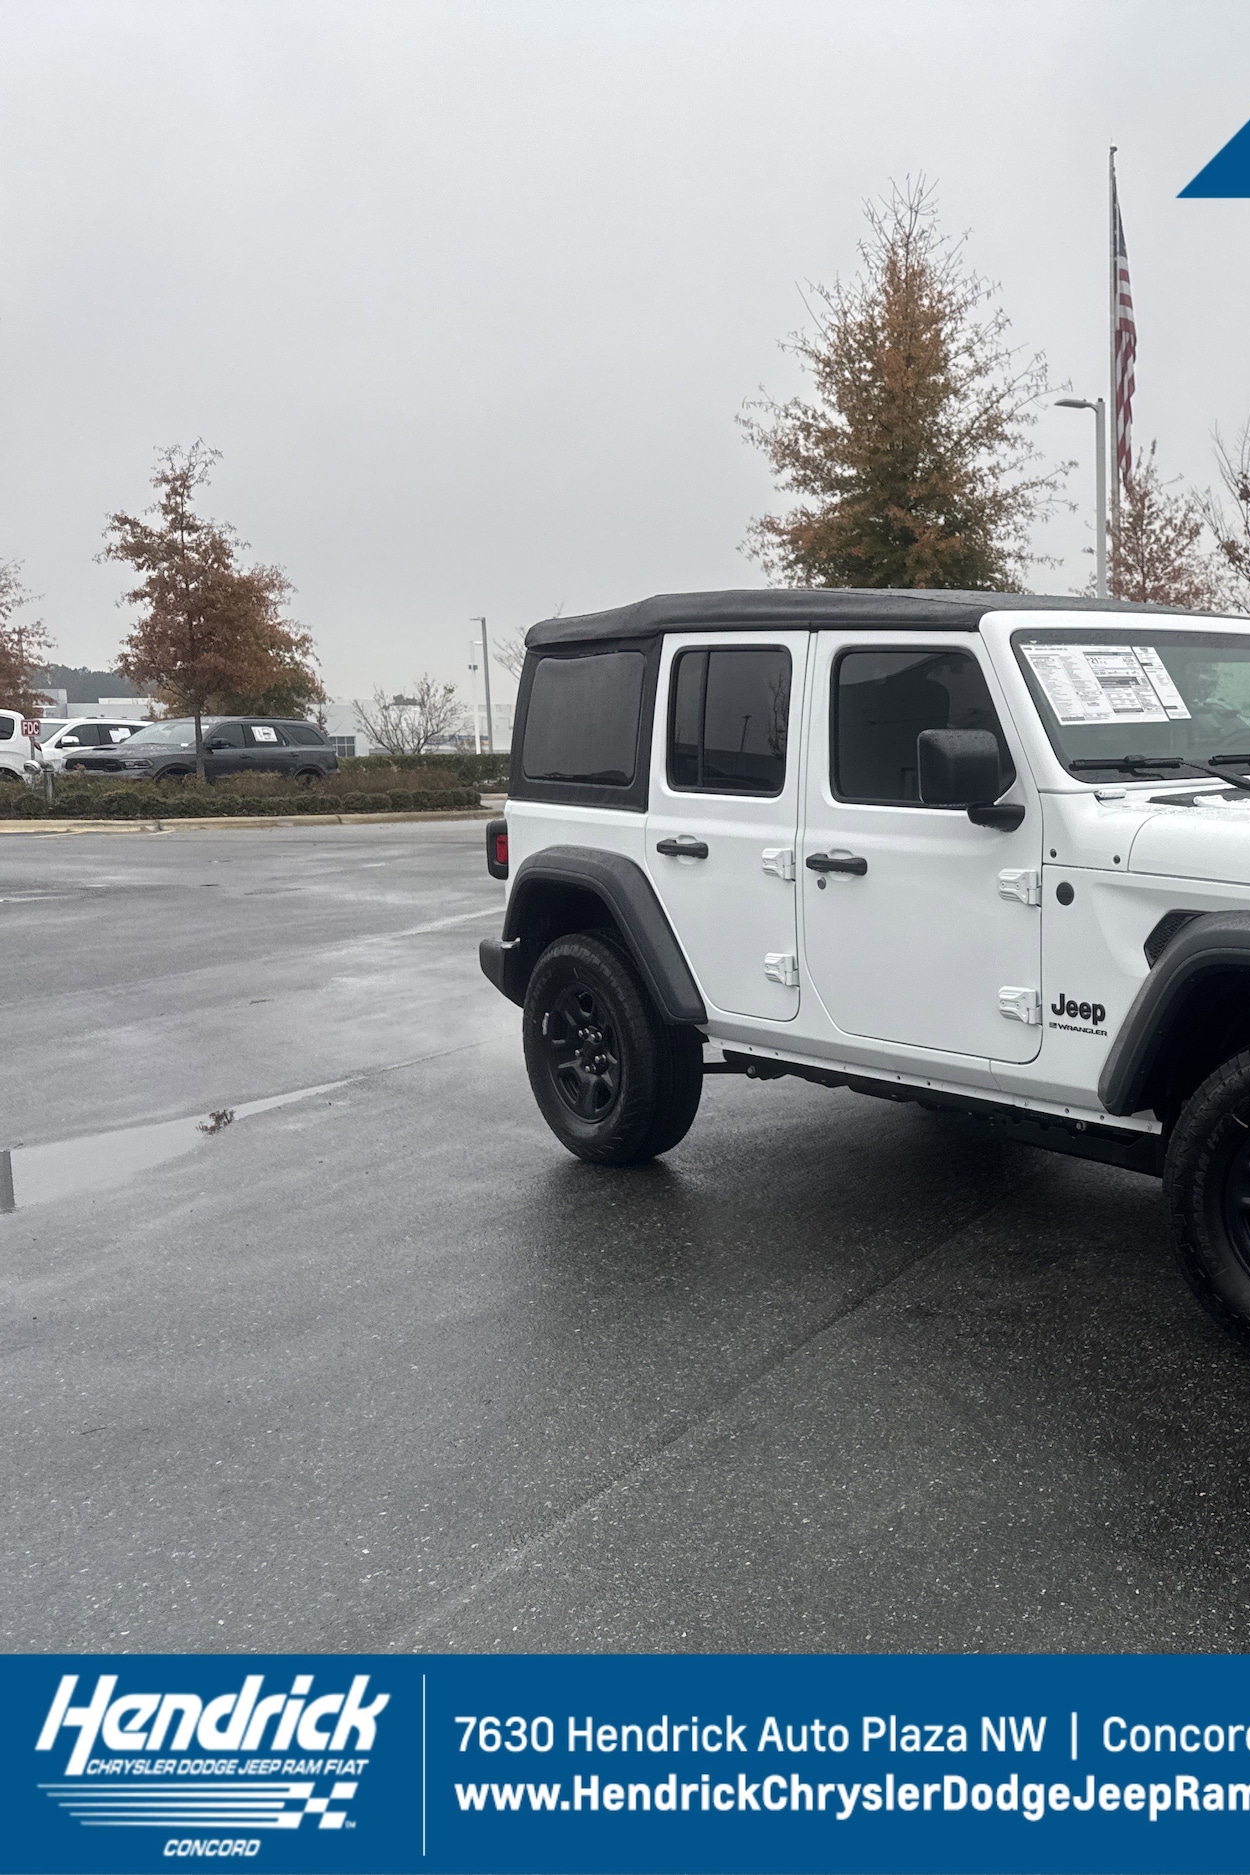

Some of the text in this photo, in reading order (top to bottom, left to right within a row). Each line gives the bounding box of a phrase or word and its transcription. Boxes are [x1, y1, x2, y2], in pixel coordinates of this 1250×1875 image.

[22, 721, 39, 735] FDC
[1051, 993, 1106, 1026] Jeep
[1058, 1023, 1108, 1036] WRANGLER
